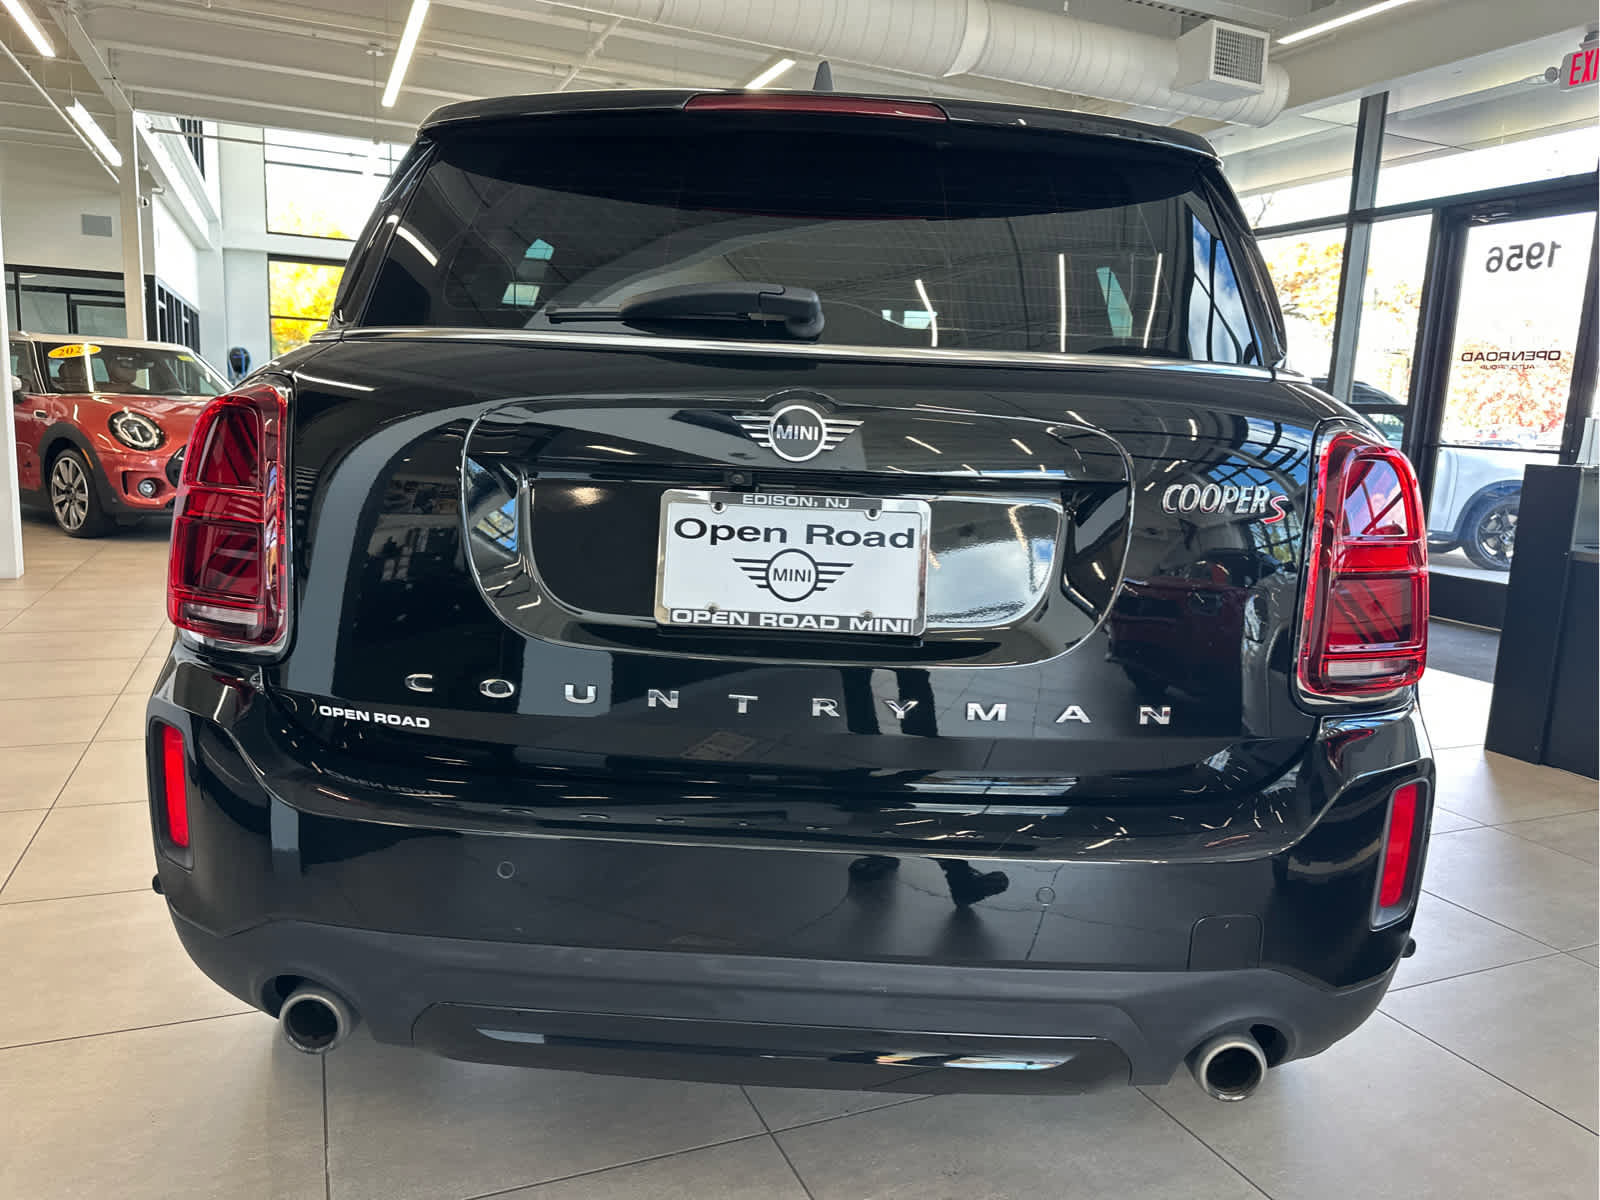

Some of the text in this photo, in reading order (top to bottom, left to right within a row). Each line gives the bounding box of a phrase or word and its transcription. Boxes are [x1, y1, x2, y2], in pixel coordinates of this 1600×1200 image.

[776, 424, 819, 441] MINI
[742, 494, 850, 509] EDISON, NJ
[673, 517, 915, 549] Open Road
[772, 567, 813, 583] MINI
[671, 609, 911, 633] OPEN ROAD MINI
[404, 673, 1172, 725] COUNTRYMAN
[319, 705, 431, 729] OPEN ROAD
